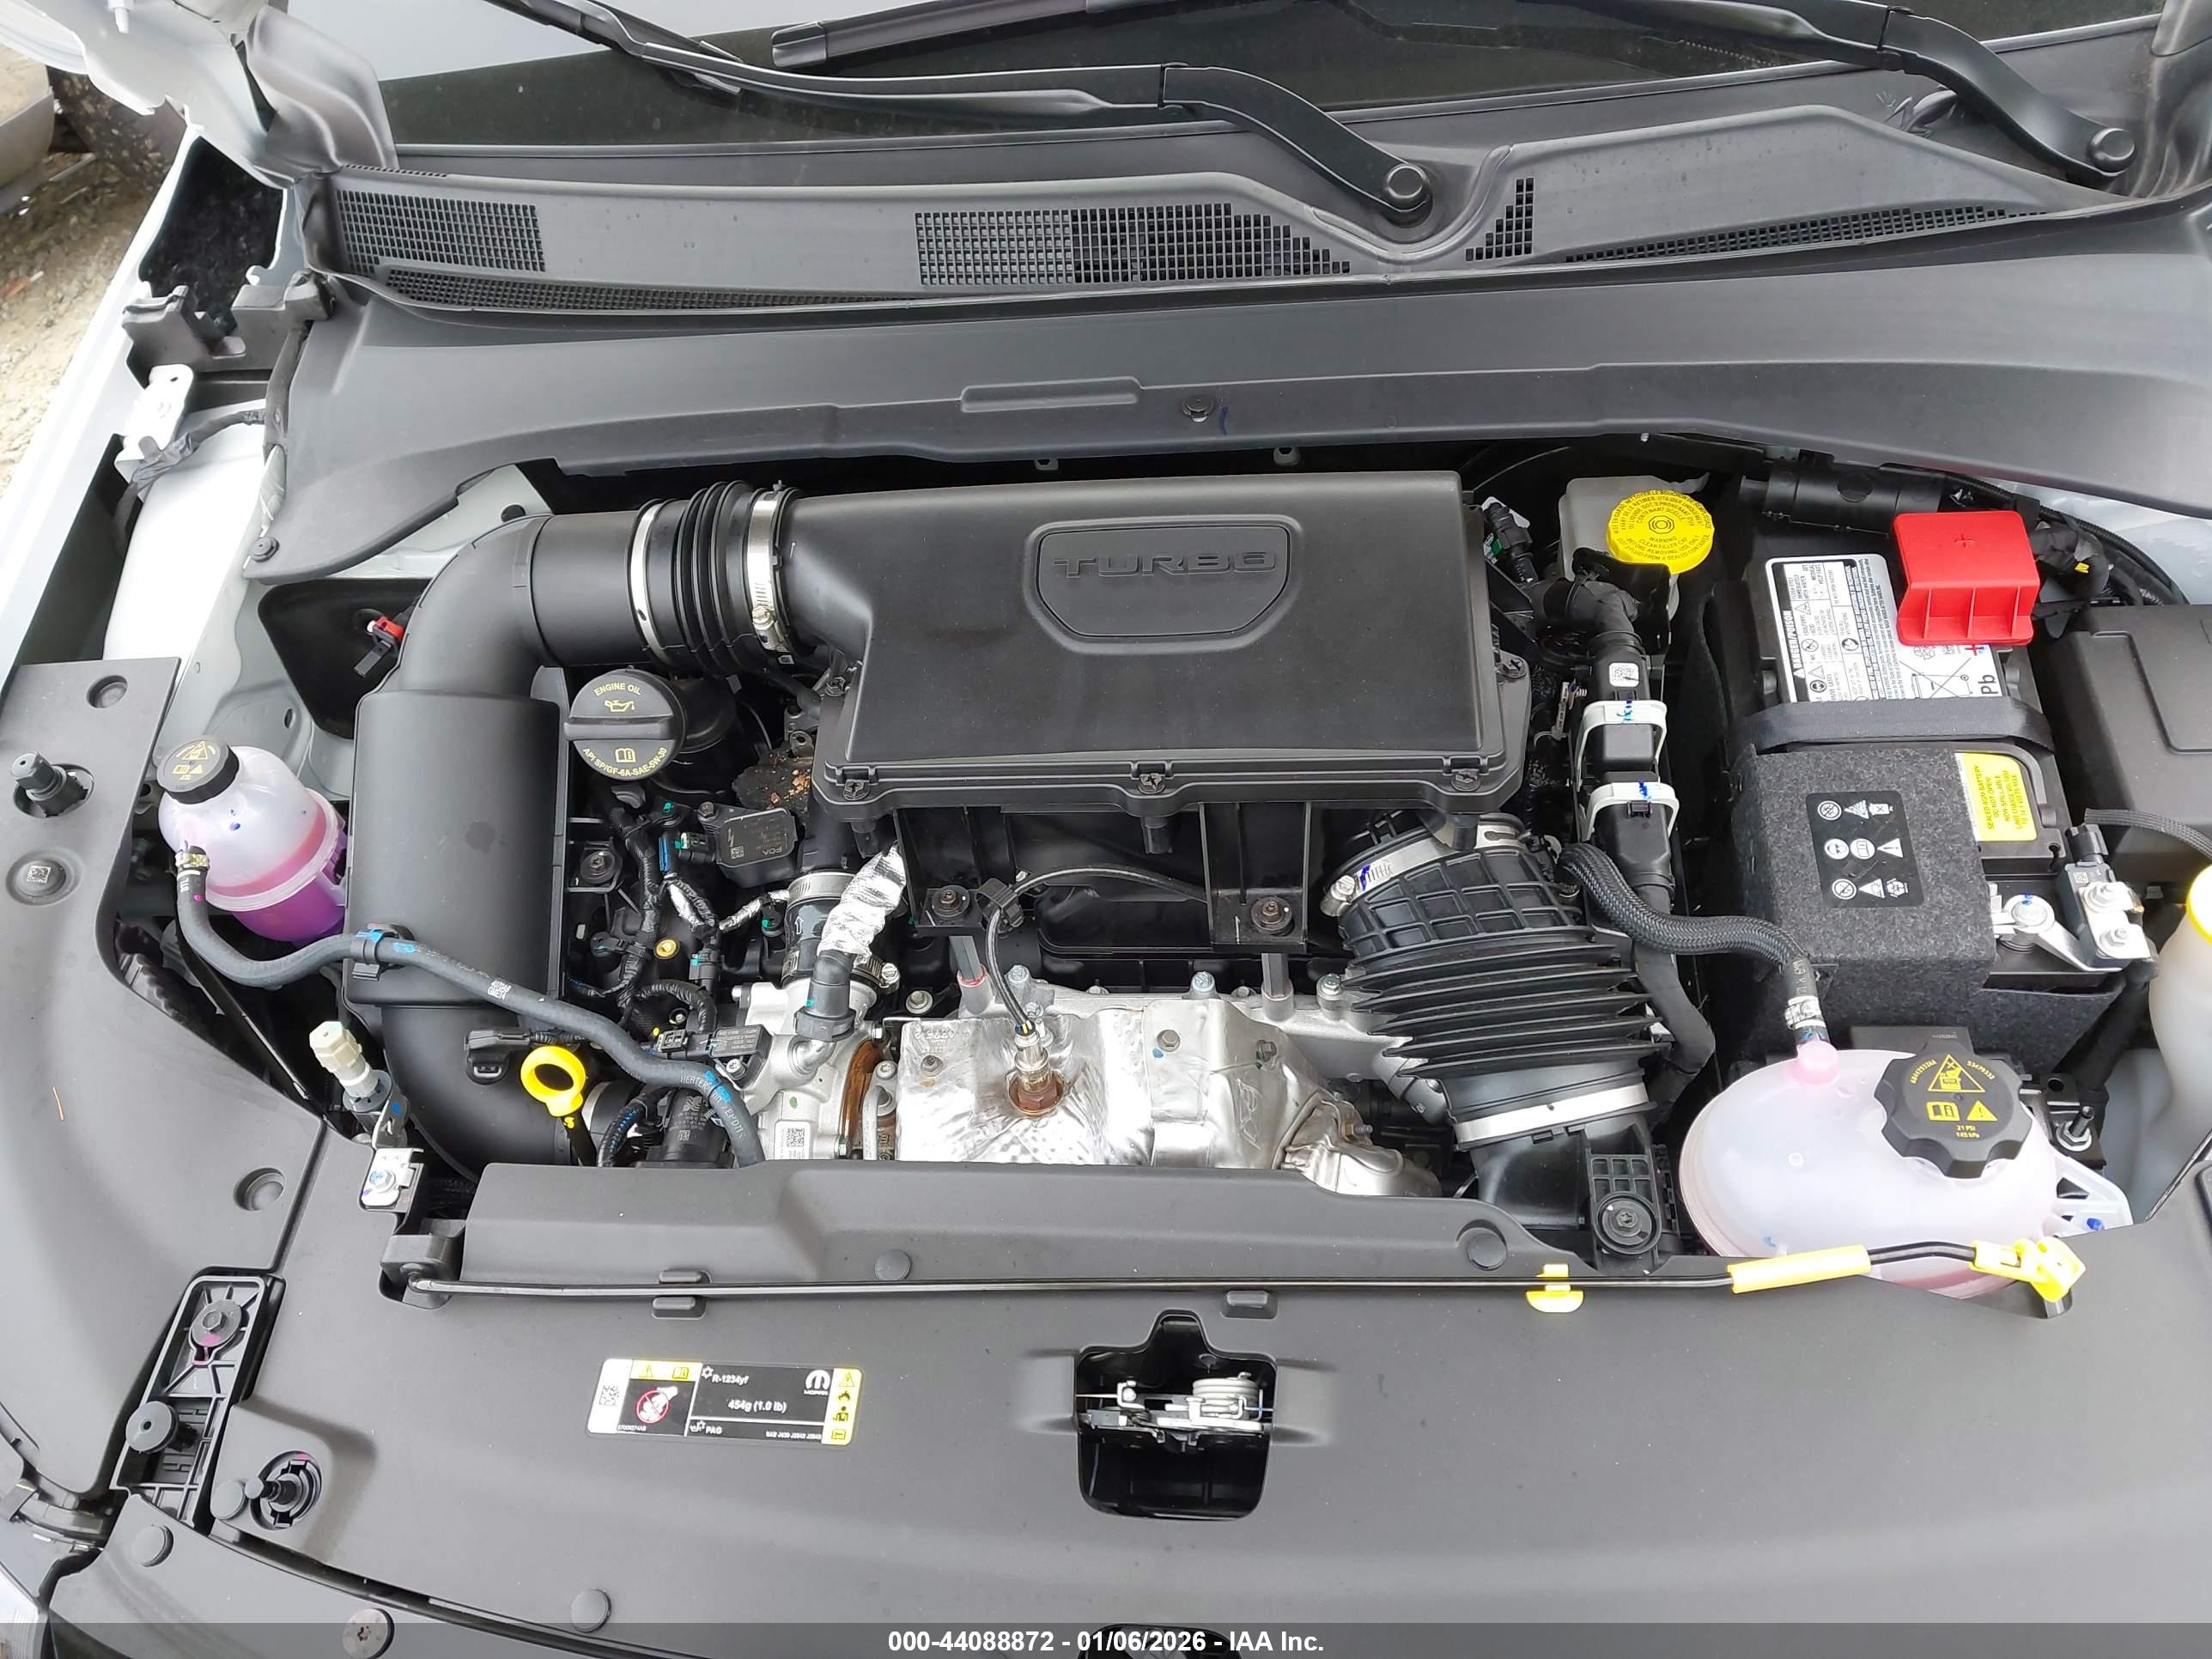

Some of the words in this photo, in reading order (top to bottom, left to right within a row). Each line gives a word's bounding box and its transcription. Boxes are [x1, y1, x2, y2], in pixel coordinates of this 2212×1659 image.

[1051, 551, 1277, 579] TURBO
[1783, 610, 1802, 669] DANGER/POISON
[593, 683, 626, 696] ENGINE
[628, 684, 642, 696] OIL
[1978, 674, 1997, 696] Pb
[582, 748, 597, 763] API
[1974, 765, 1984, 791] BATTERY
[1984, 806, 1994, 830] SEALED
[711, 1374, 750, 1385] R-1234yf
[728, 1399, 752, 1413] 454g
[753, 1401, 772, 1413] (1.0
[705, 1426, 722, 1435] PAG
